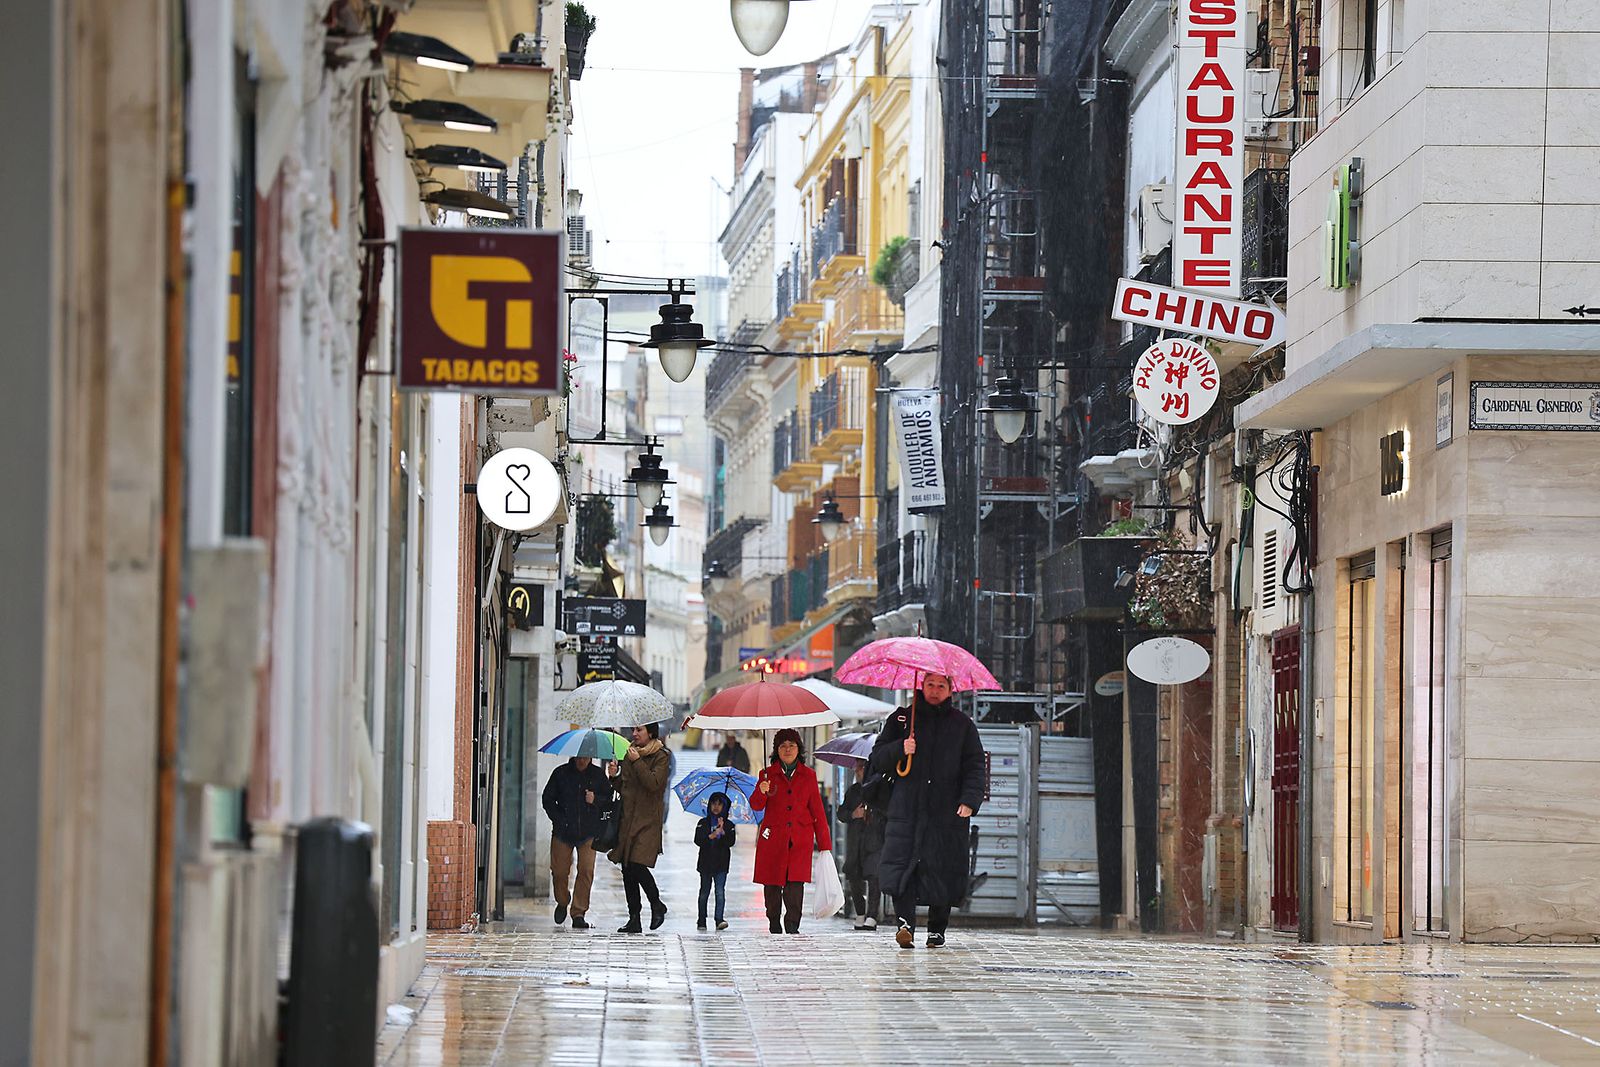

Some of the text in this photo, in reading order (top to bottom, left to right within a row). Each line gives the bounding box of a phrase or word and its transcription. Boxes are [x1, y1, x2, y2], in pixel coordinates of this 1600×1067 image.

[1121, 287, 1275, 340] CHINO
[421, 358, 539, 383] TABACOS
[1161, 361, 1189, 418] 神州
[1170, 342, 1217, 390] DIVINO
[901, 412, 925, 488] ALQUILER DE
[915, 410, 938, 487] ANDAMIOS
